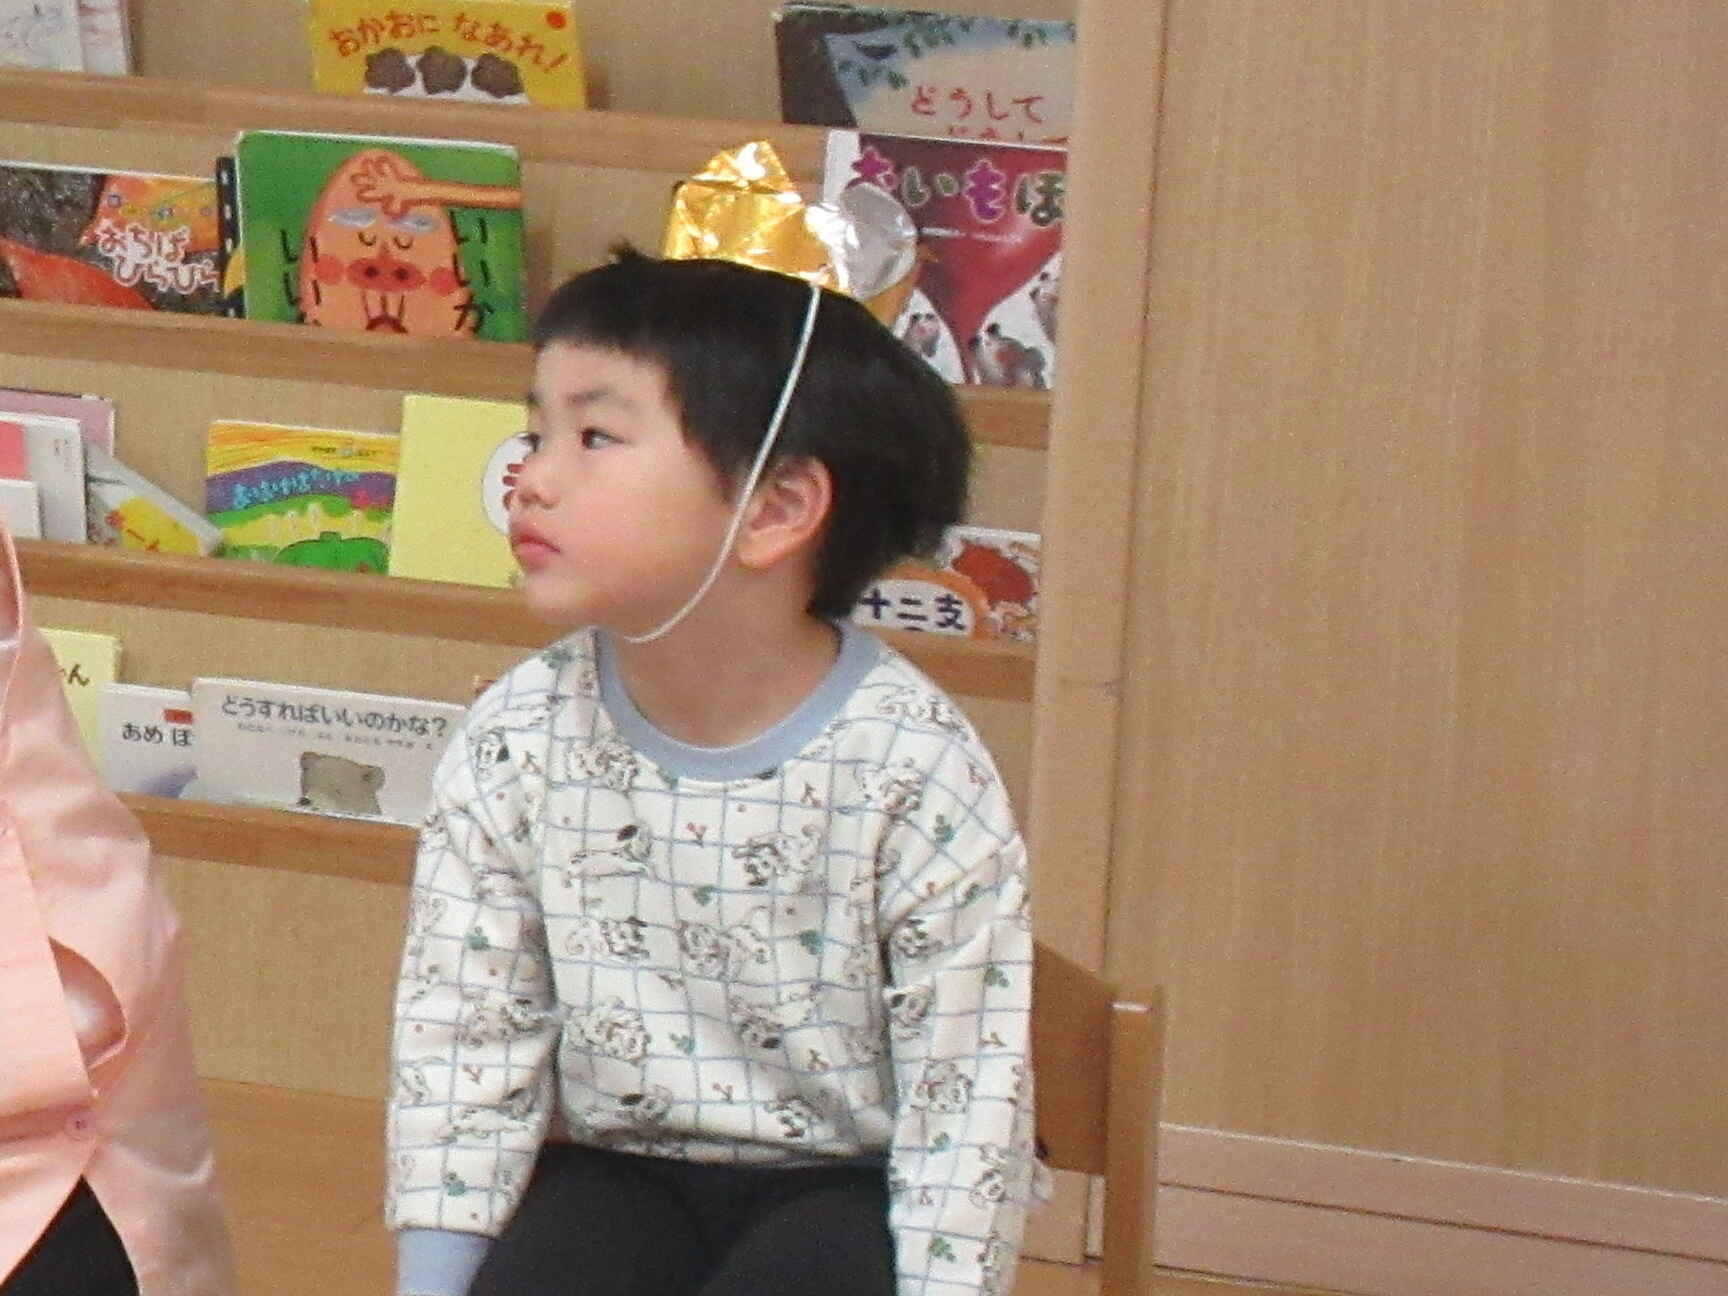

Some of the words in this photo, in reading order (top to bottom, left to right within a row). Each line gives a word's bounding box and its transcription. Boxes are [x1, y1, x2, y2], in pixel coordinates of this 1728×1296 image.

[912, 85, 1044, 124] どうして
[97, 219, 191, 264] おちば
[862, 588, 966, 630] 十二支
[121, 722, 165, 746] あめ
[221, 693, 449, 738] どうすればいいのかな?
